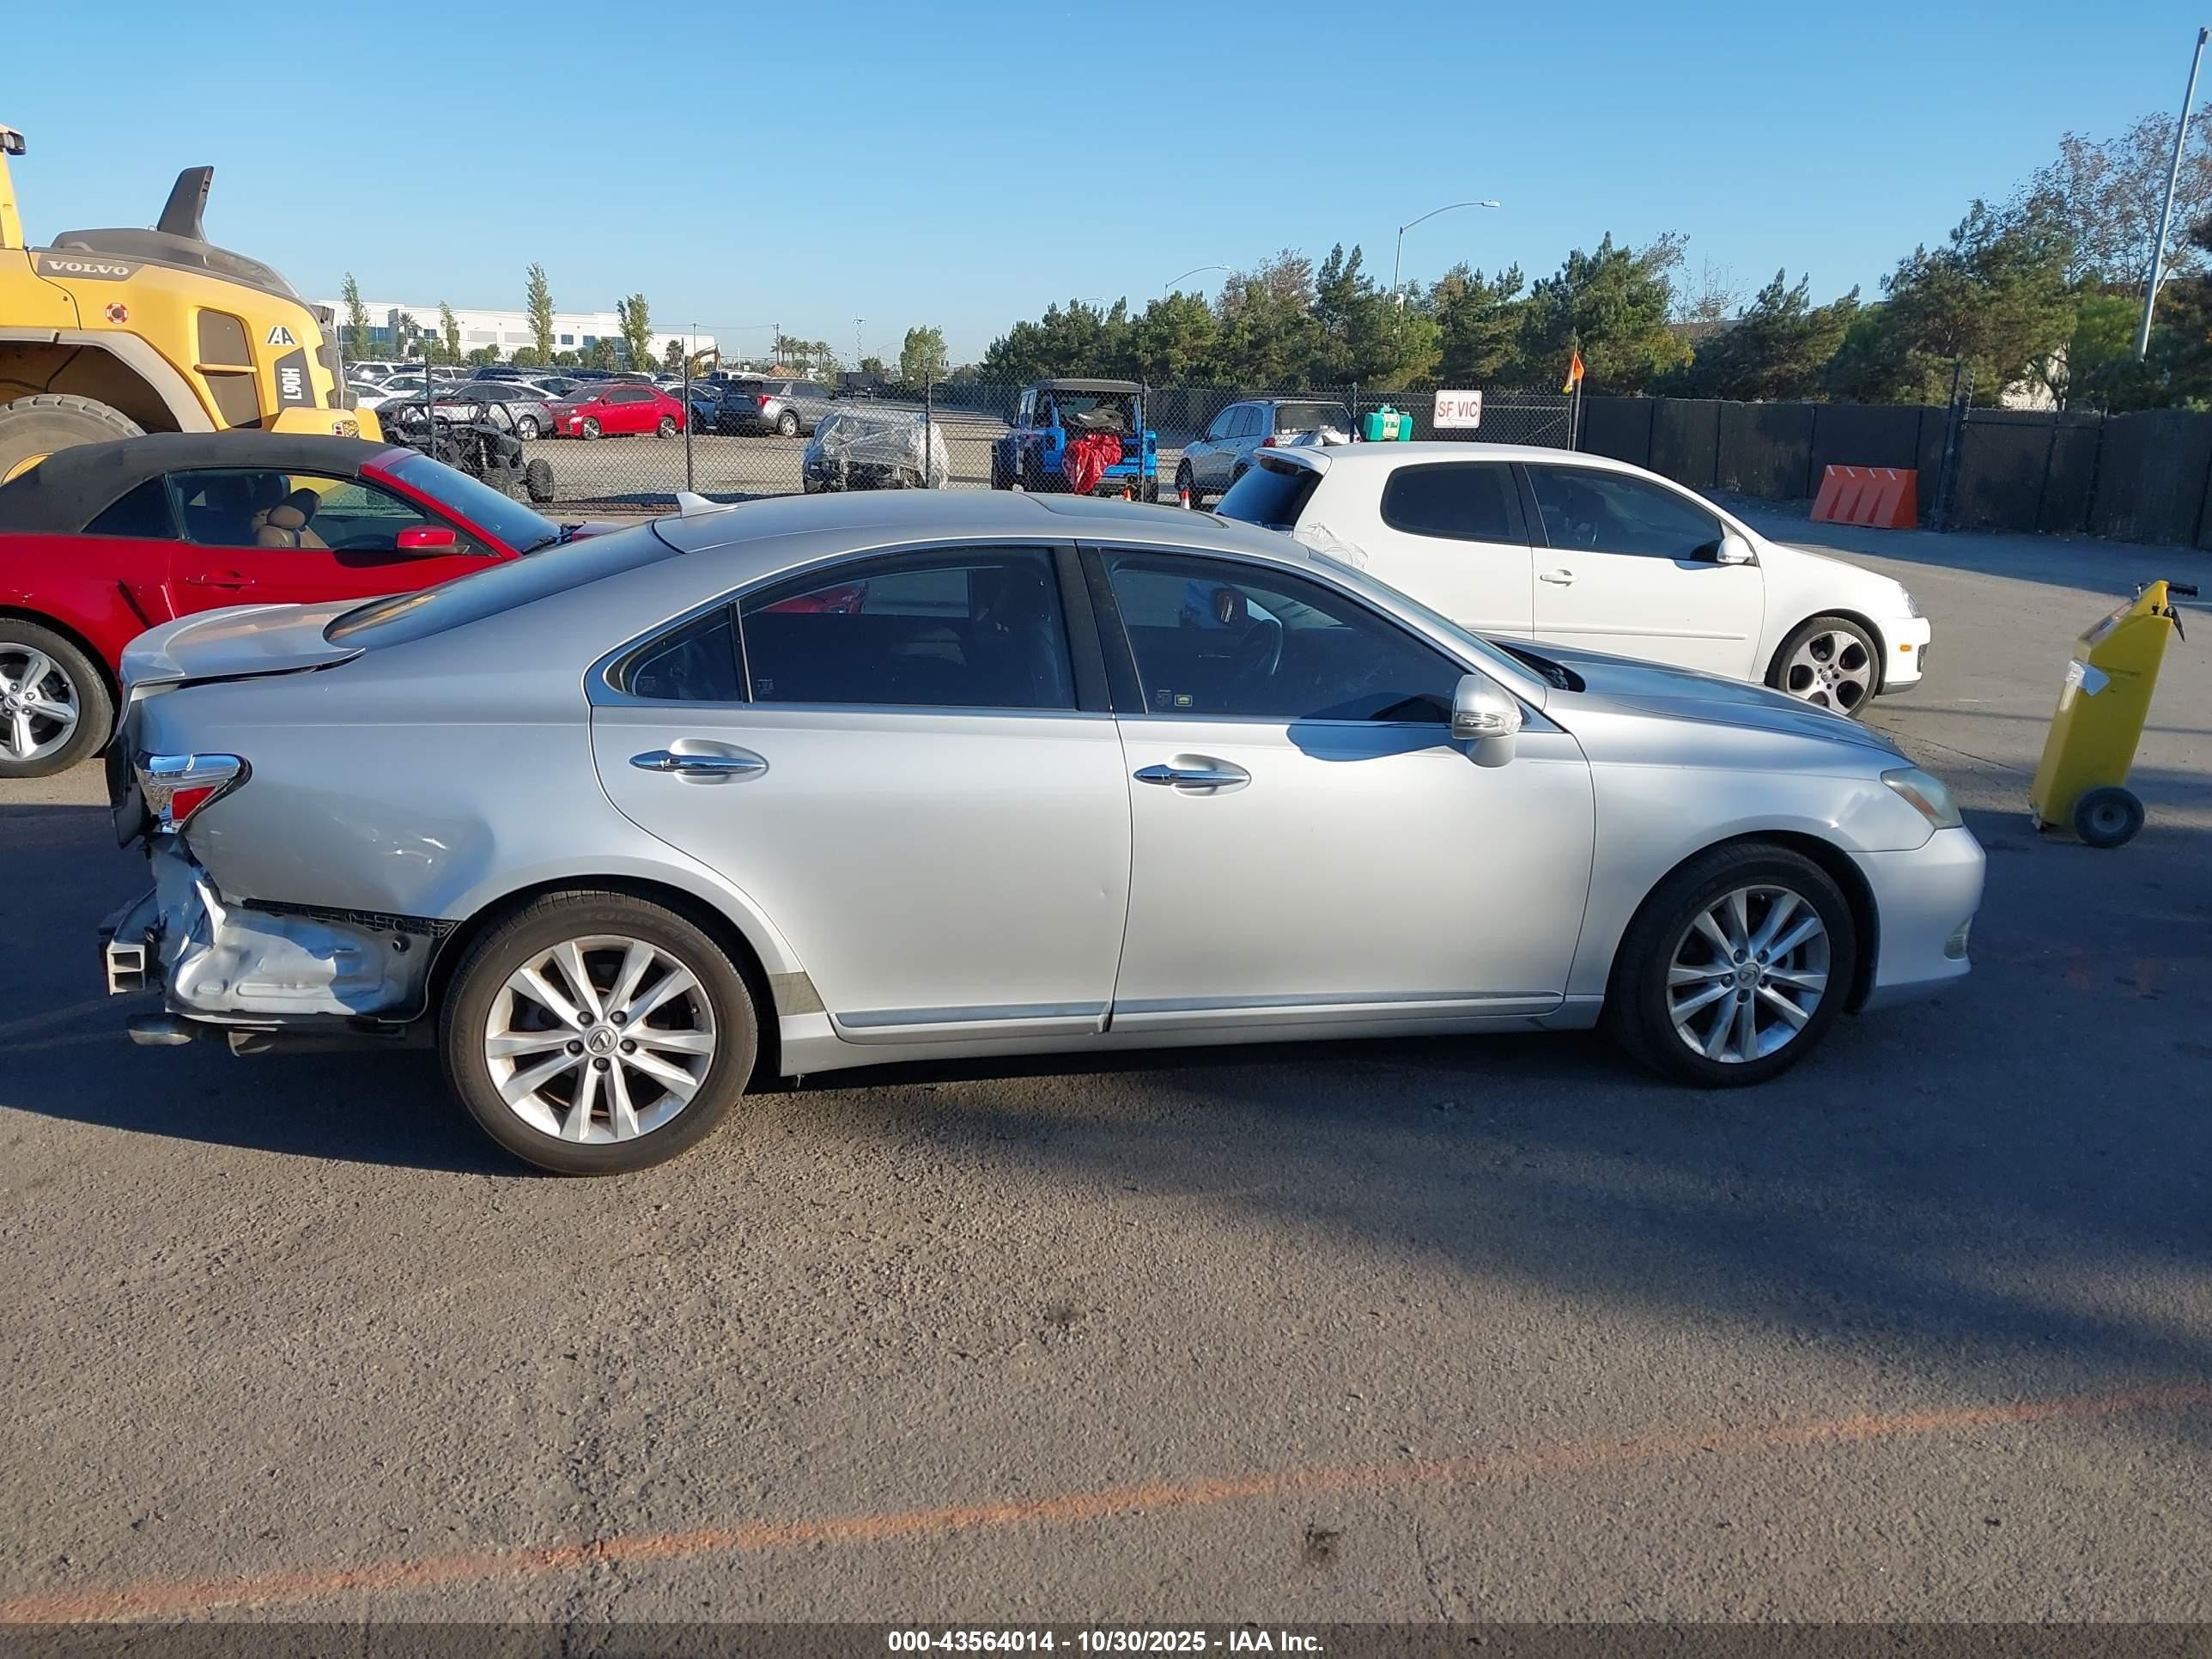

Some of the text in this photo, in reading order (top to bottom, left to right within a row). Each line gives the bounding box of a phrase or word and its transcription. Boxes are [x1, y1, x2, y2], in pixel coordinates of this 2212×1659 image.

[47, 260, 129, 275] VOLVO
[281, 368, 302, 400] L90H
[1437, 400, 1479, 418] SF VIC
